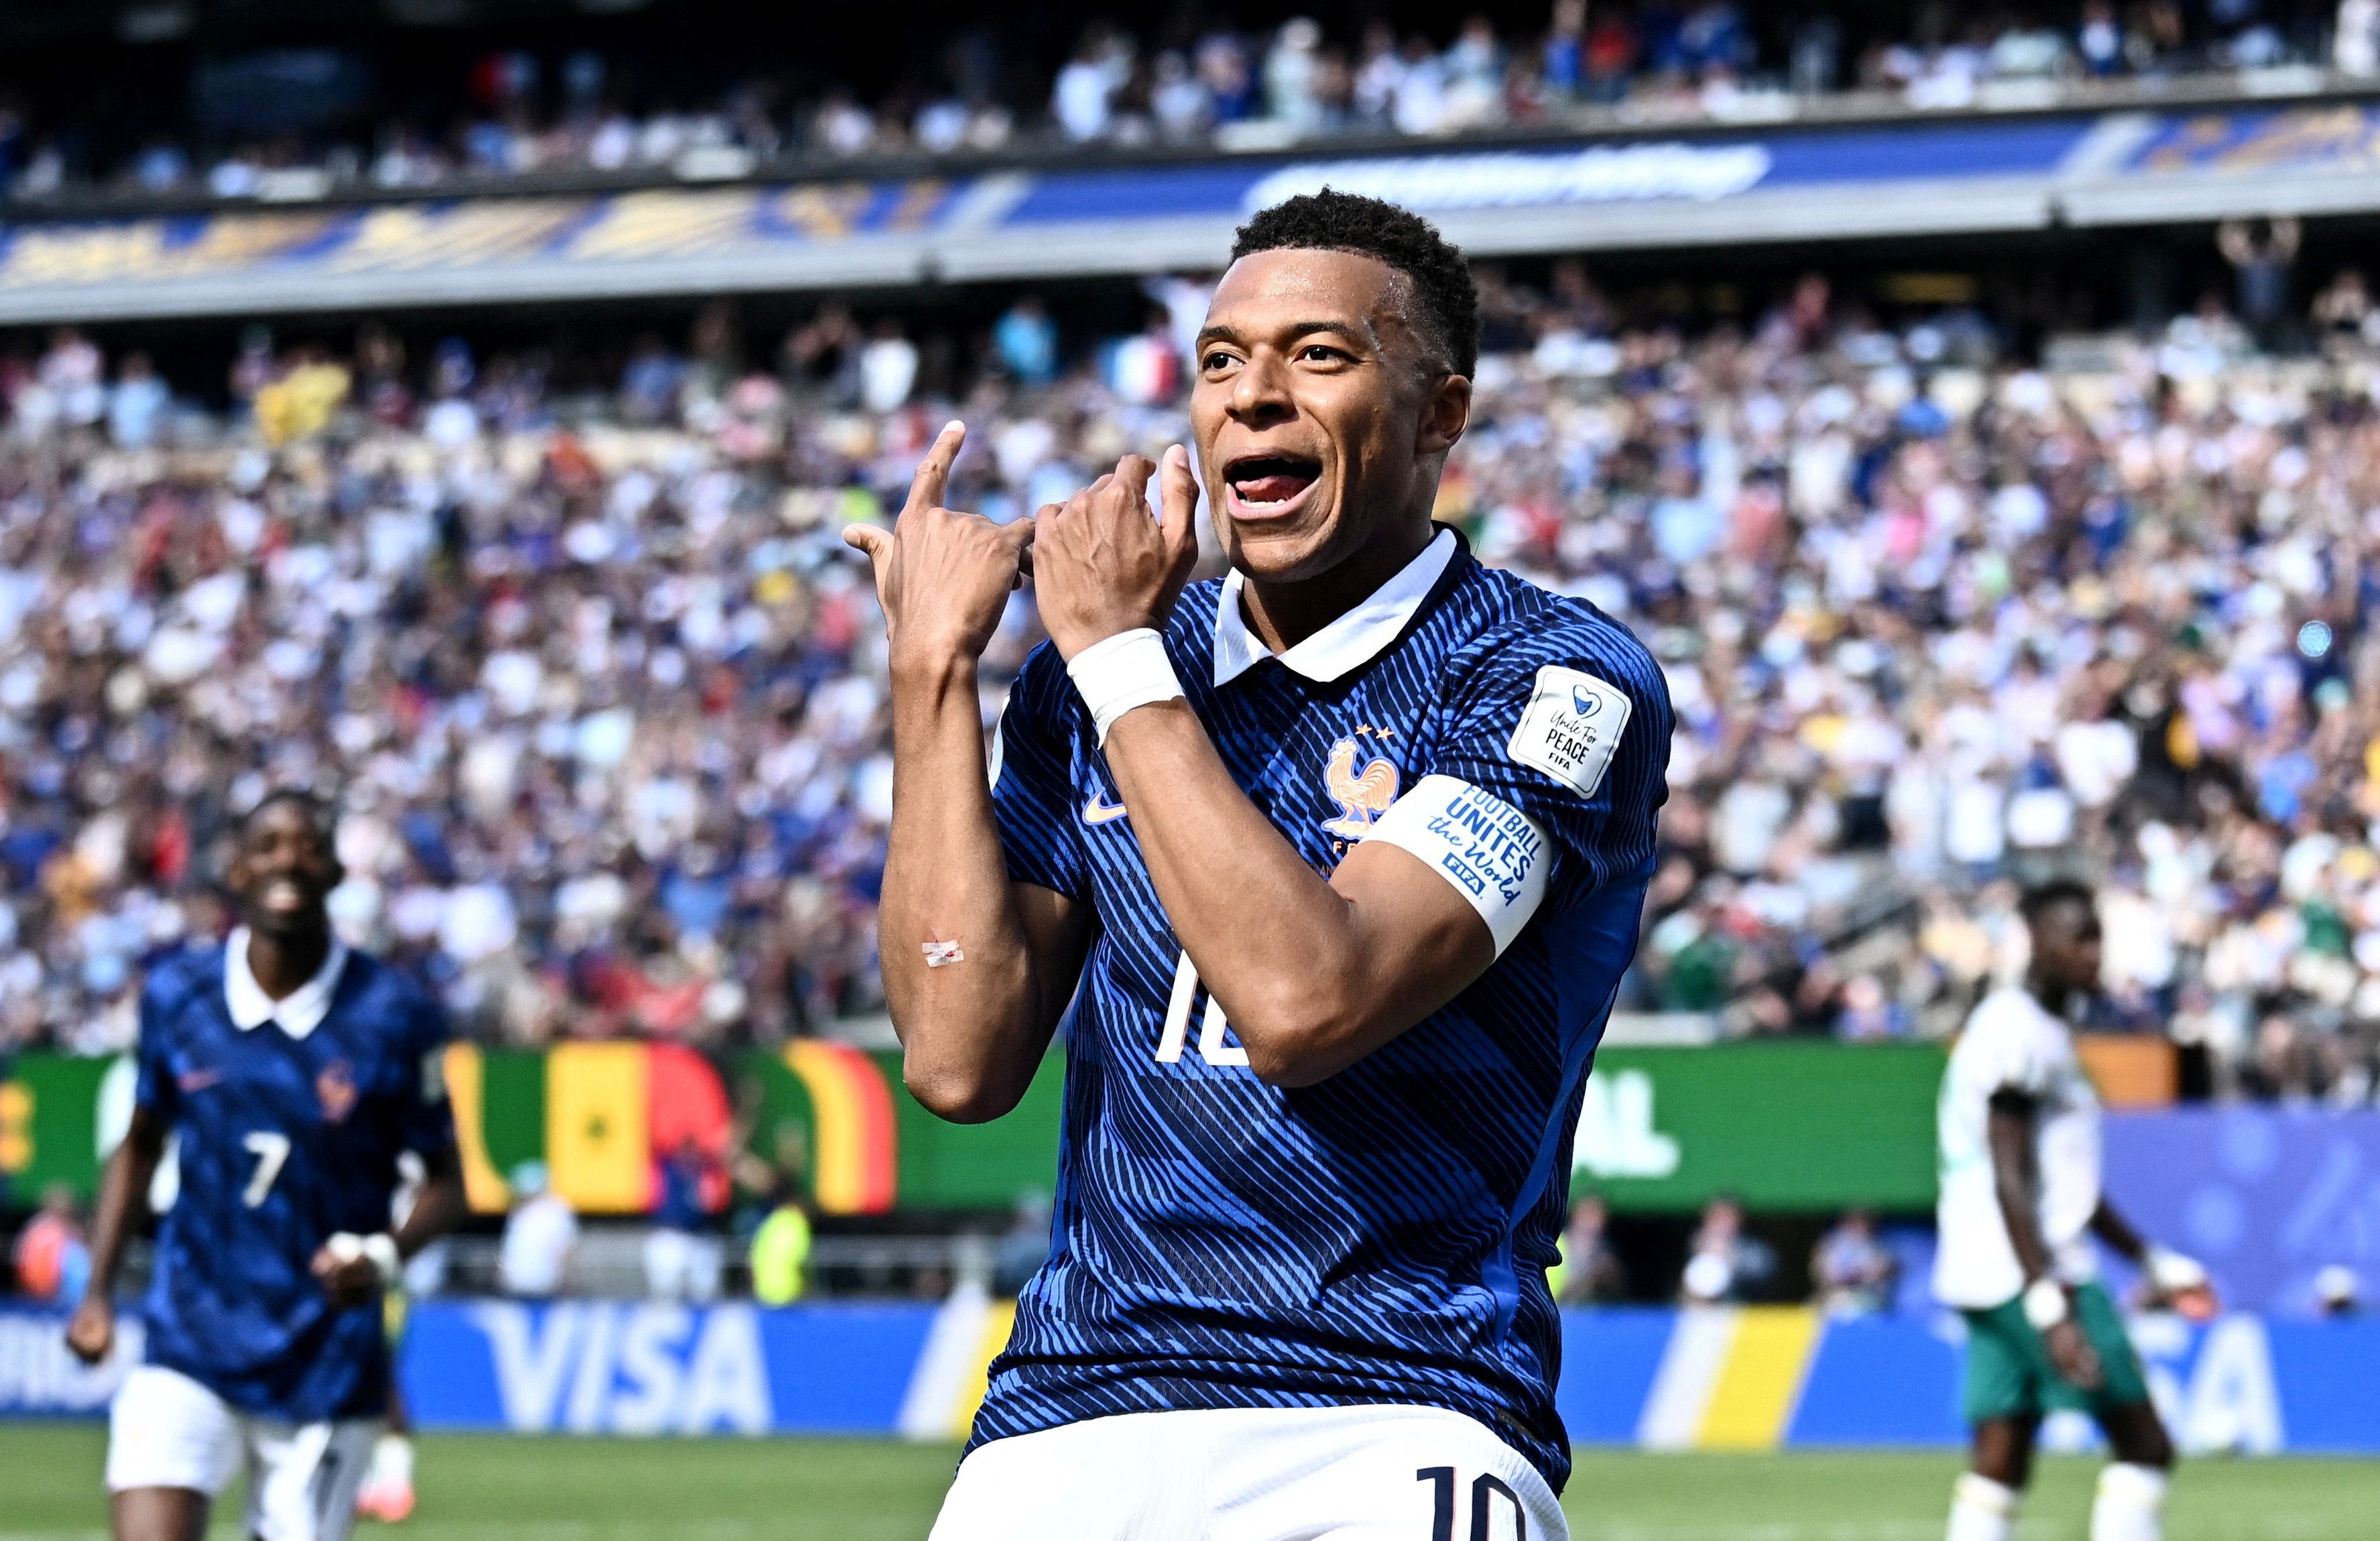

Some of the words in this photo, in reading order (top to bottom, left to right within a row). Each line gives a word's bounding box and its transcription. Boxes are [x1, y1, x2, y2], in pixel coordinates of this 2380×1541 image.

[1545, 728, 1590, 765] PEACE
[1548, 752, 1570, 771] FIFA
[1581, 726, 1597, 744] For
[1427, 814, 1464, 847] the
[1464, 841, 1522, 908] World
[1446, 796, 1531, 882] UNITES
[1463, 784, 1542, 862] FOOTBALL
[1443, 853, 1484, 895] FIFA
[242, 1129, 292, 1209] 7
[469, 1302, 778, 1434] VISA
[1416, 1466, 1527, 1541] 10
